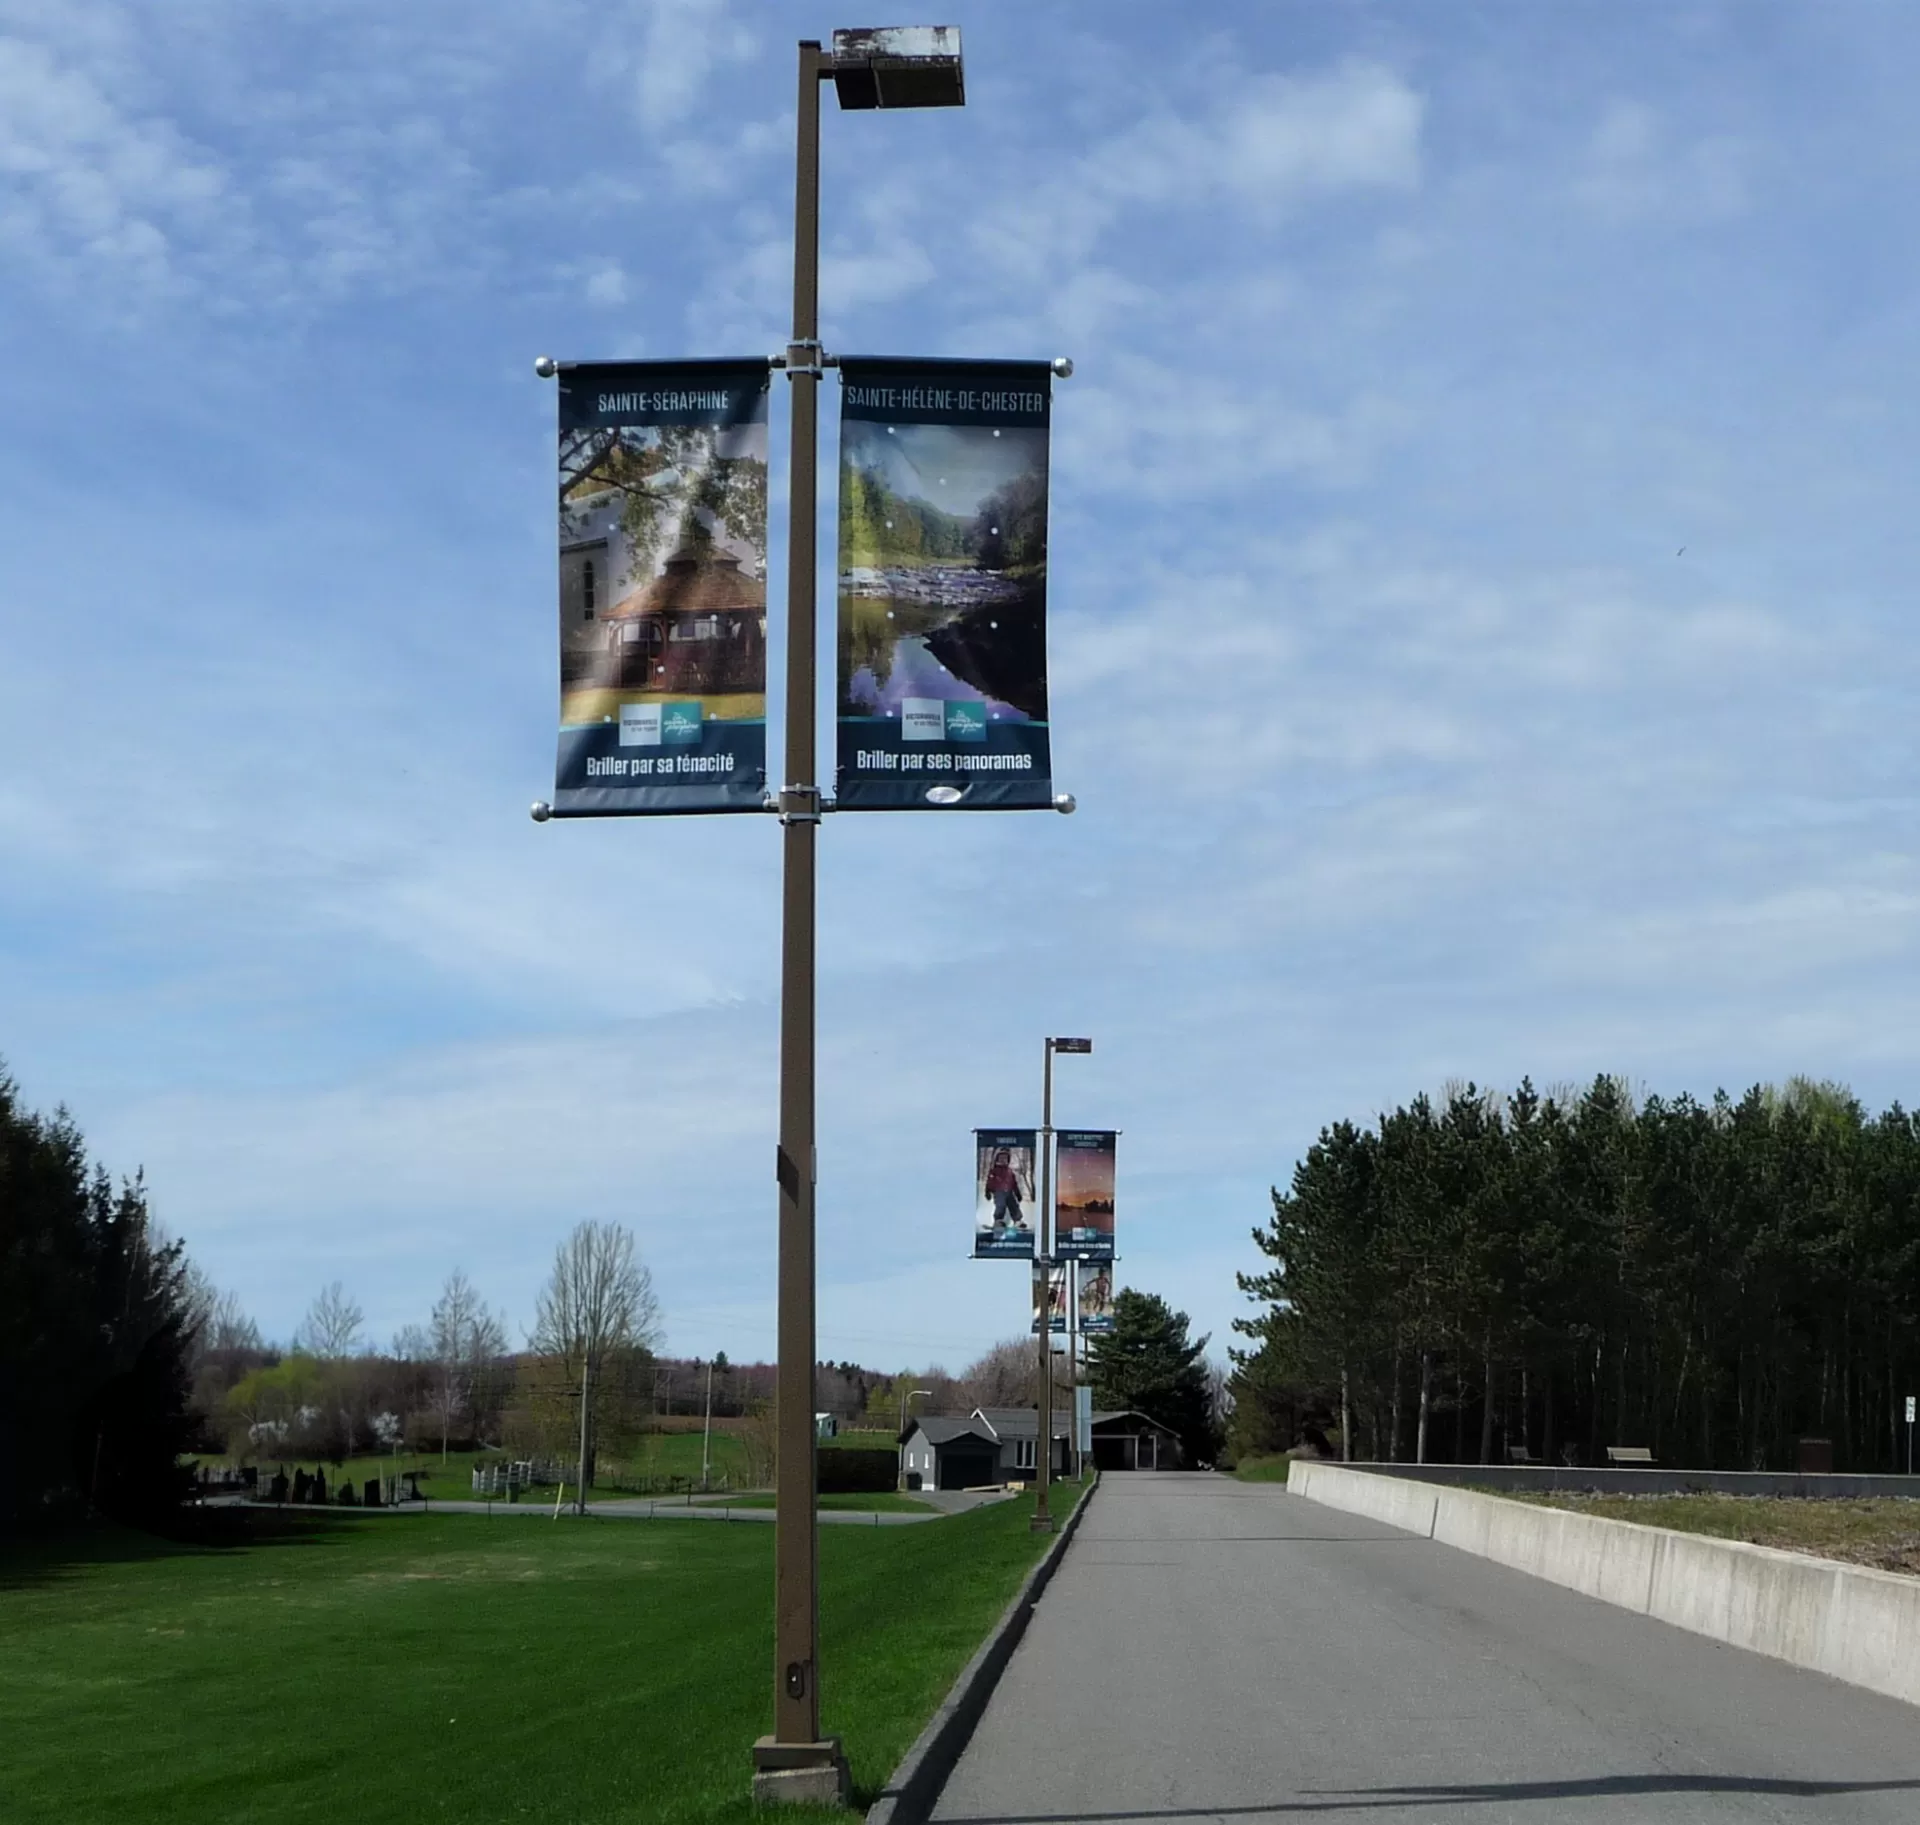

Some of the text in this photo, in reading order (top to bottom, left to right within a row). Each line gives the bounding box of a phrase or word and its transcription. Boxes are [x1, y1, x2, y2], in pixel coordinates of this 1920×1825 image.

[598, 389, 729, 412] SAINTE-SÉRAPHINE
[847, 386, 1043, 412] SAINTE-HÉLÈNE-DE-CHESTER
[586, 752, 735, 777] Briller par sa ténacité
[857, 750, 1032, 771] Briller par ses panoramas
